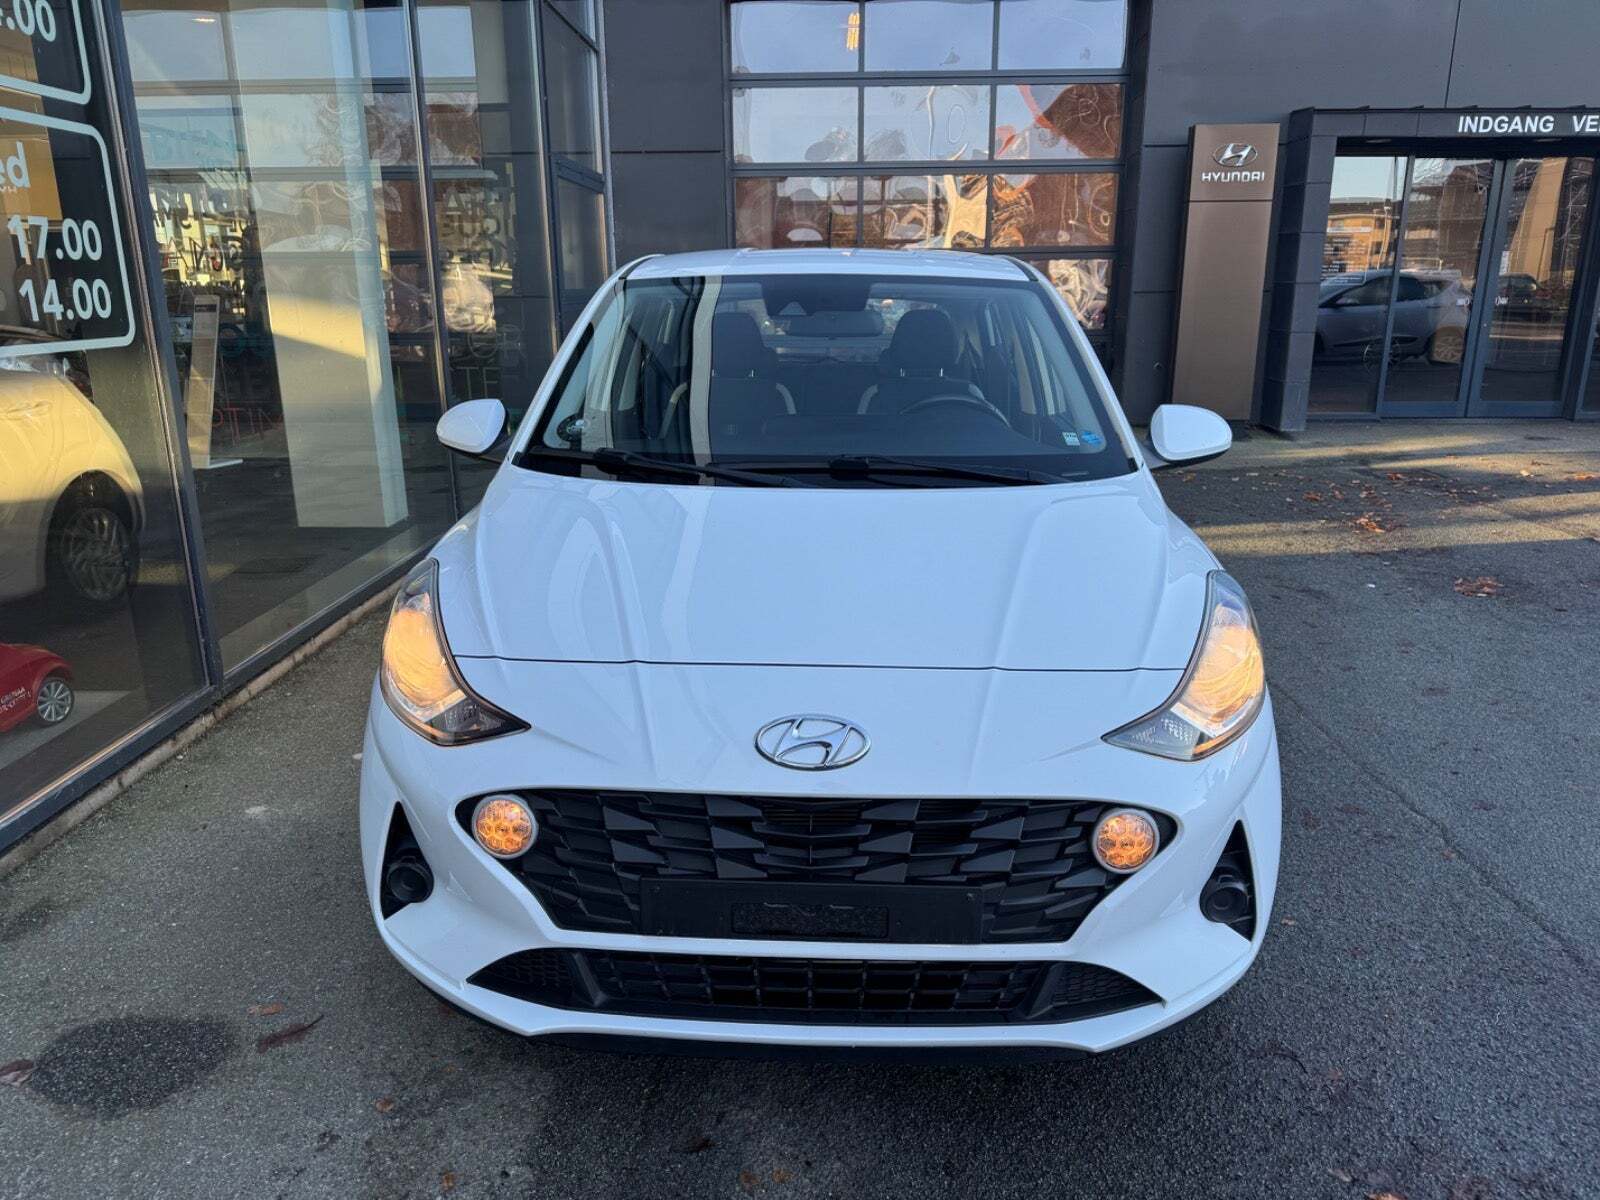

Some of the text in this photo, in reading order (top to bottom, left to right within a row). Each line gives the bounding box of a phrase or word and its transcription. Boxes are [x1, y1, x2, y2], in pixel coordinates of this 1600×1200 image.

[0, 0, 57, 42] .00
[1457, 115, 1600, 133] INDGANG VE
[1201, 171, 1265, 182] HYUNDAI
[8, 215, 102, 260] 17.00
[19, 279, 112, 321] 14.00
